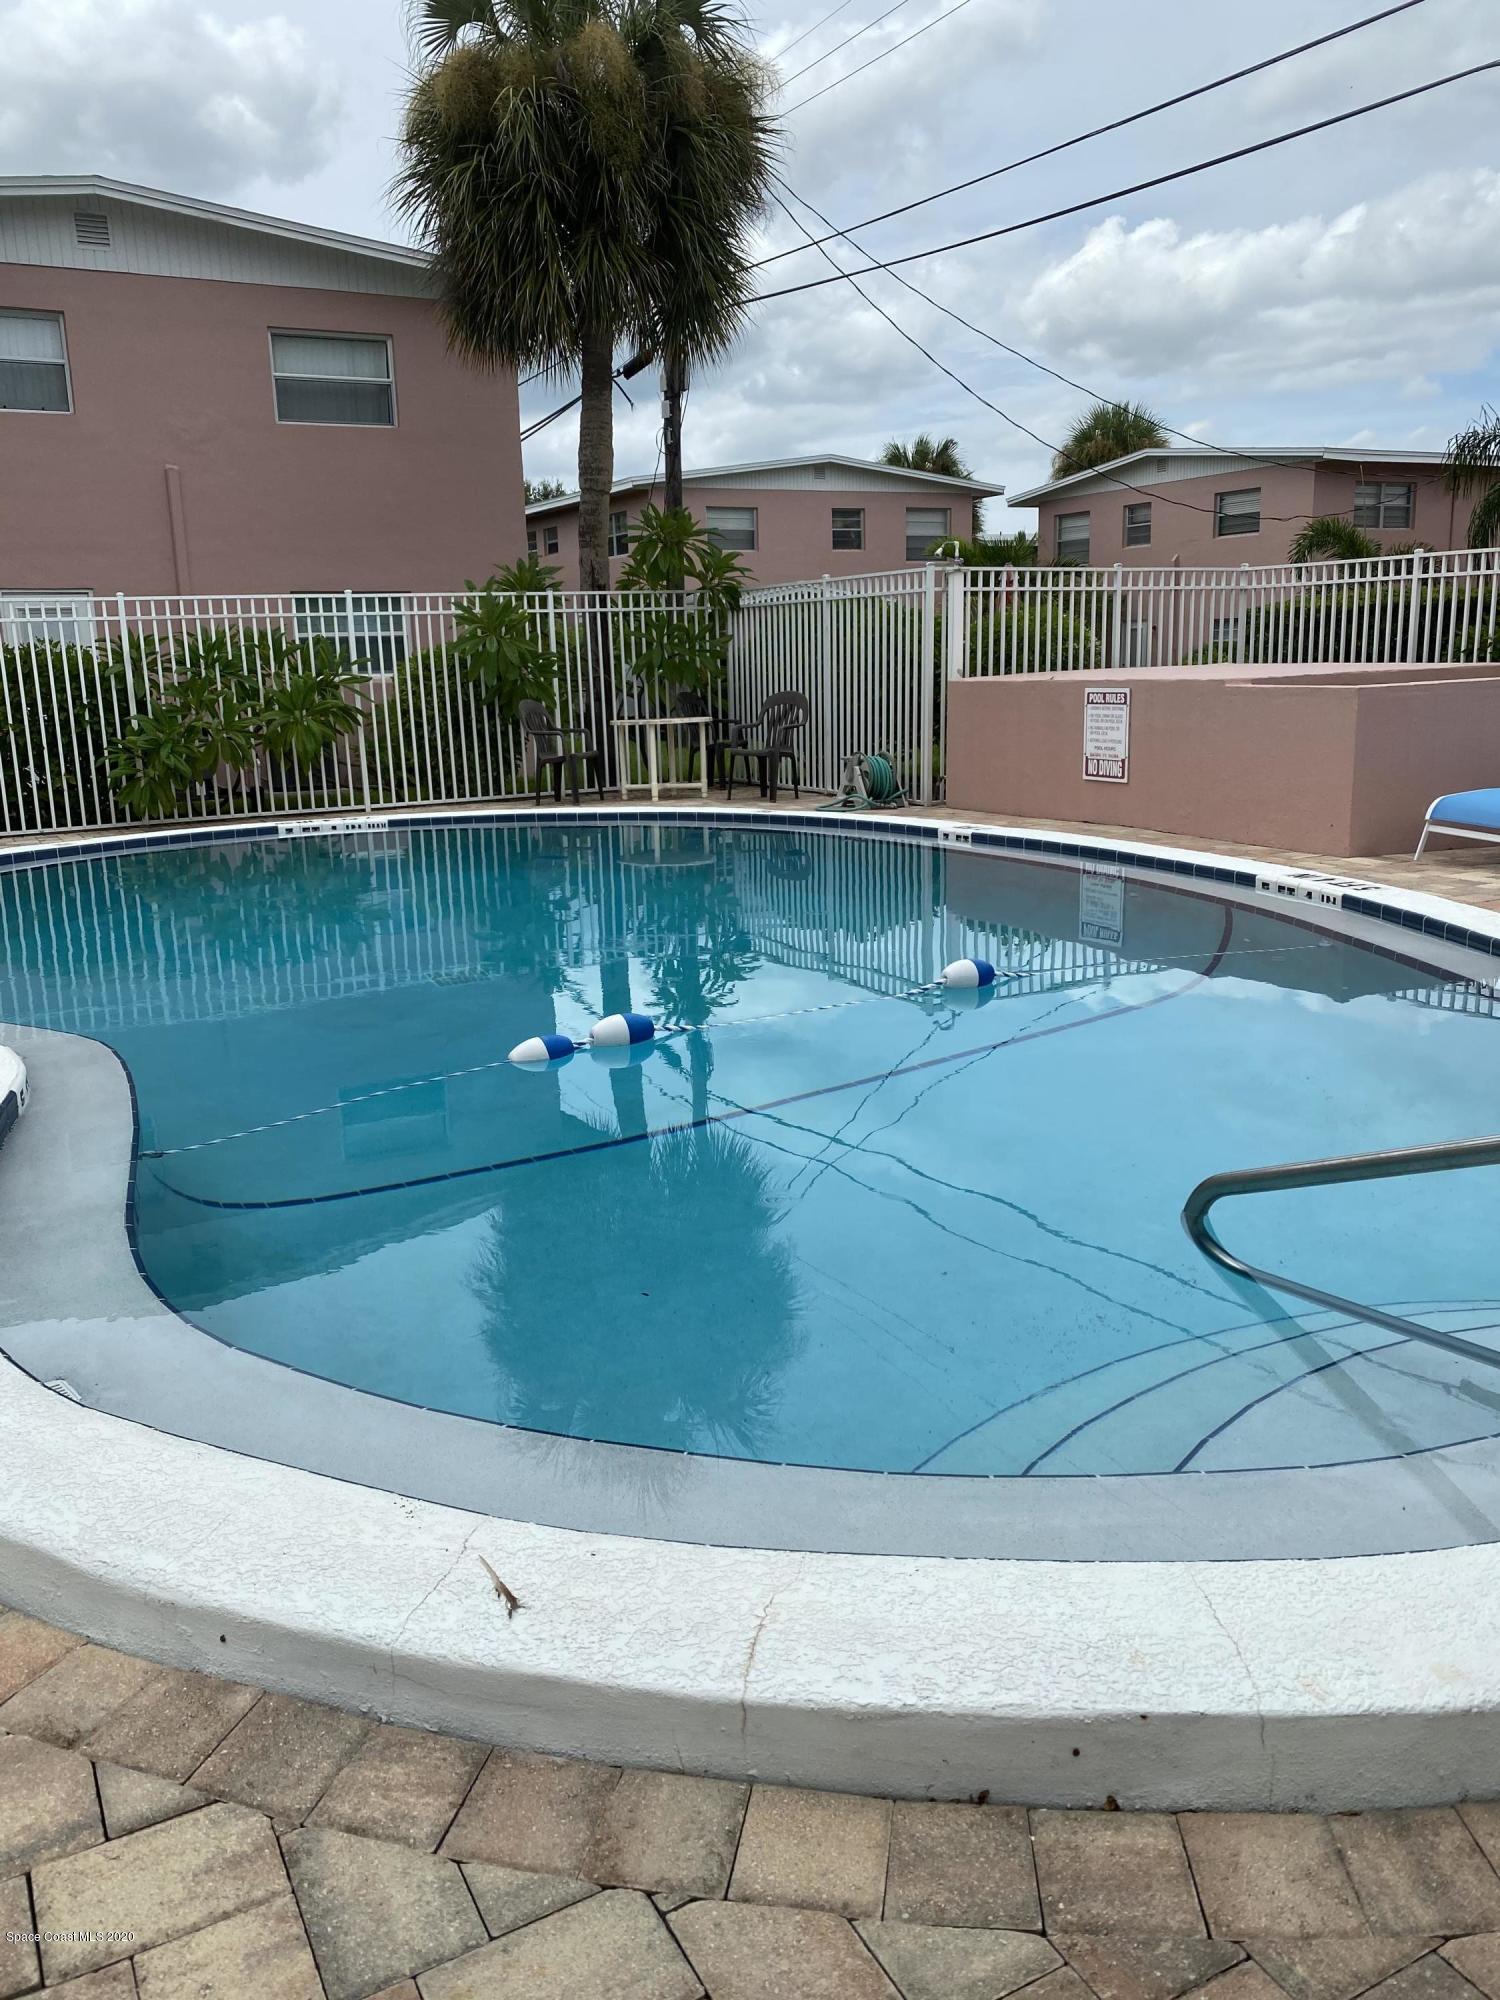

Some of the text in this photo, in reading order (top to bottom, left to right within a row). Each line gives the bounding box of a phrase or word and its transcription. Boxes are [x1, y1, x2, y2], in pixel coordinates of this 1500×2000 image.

[1089, 693, 1125, 704] POOL RULES
[1088, 759, 1123, 777] NO DIVING
[1321, 894, 1337, 905] IN
